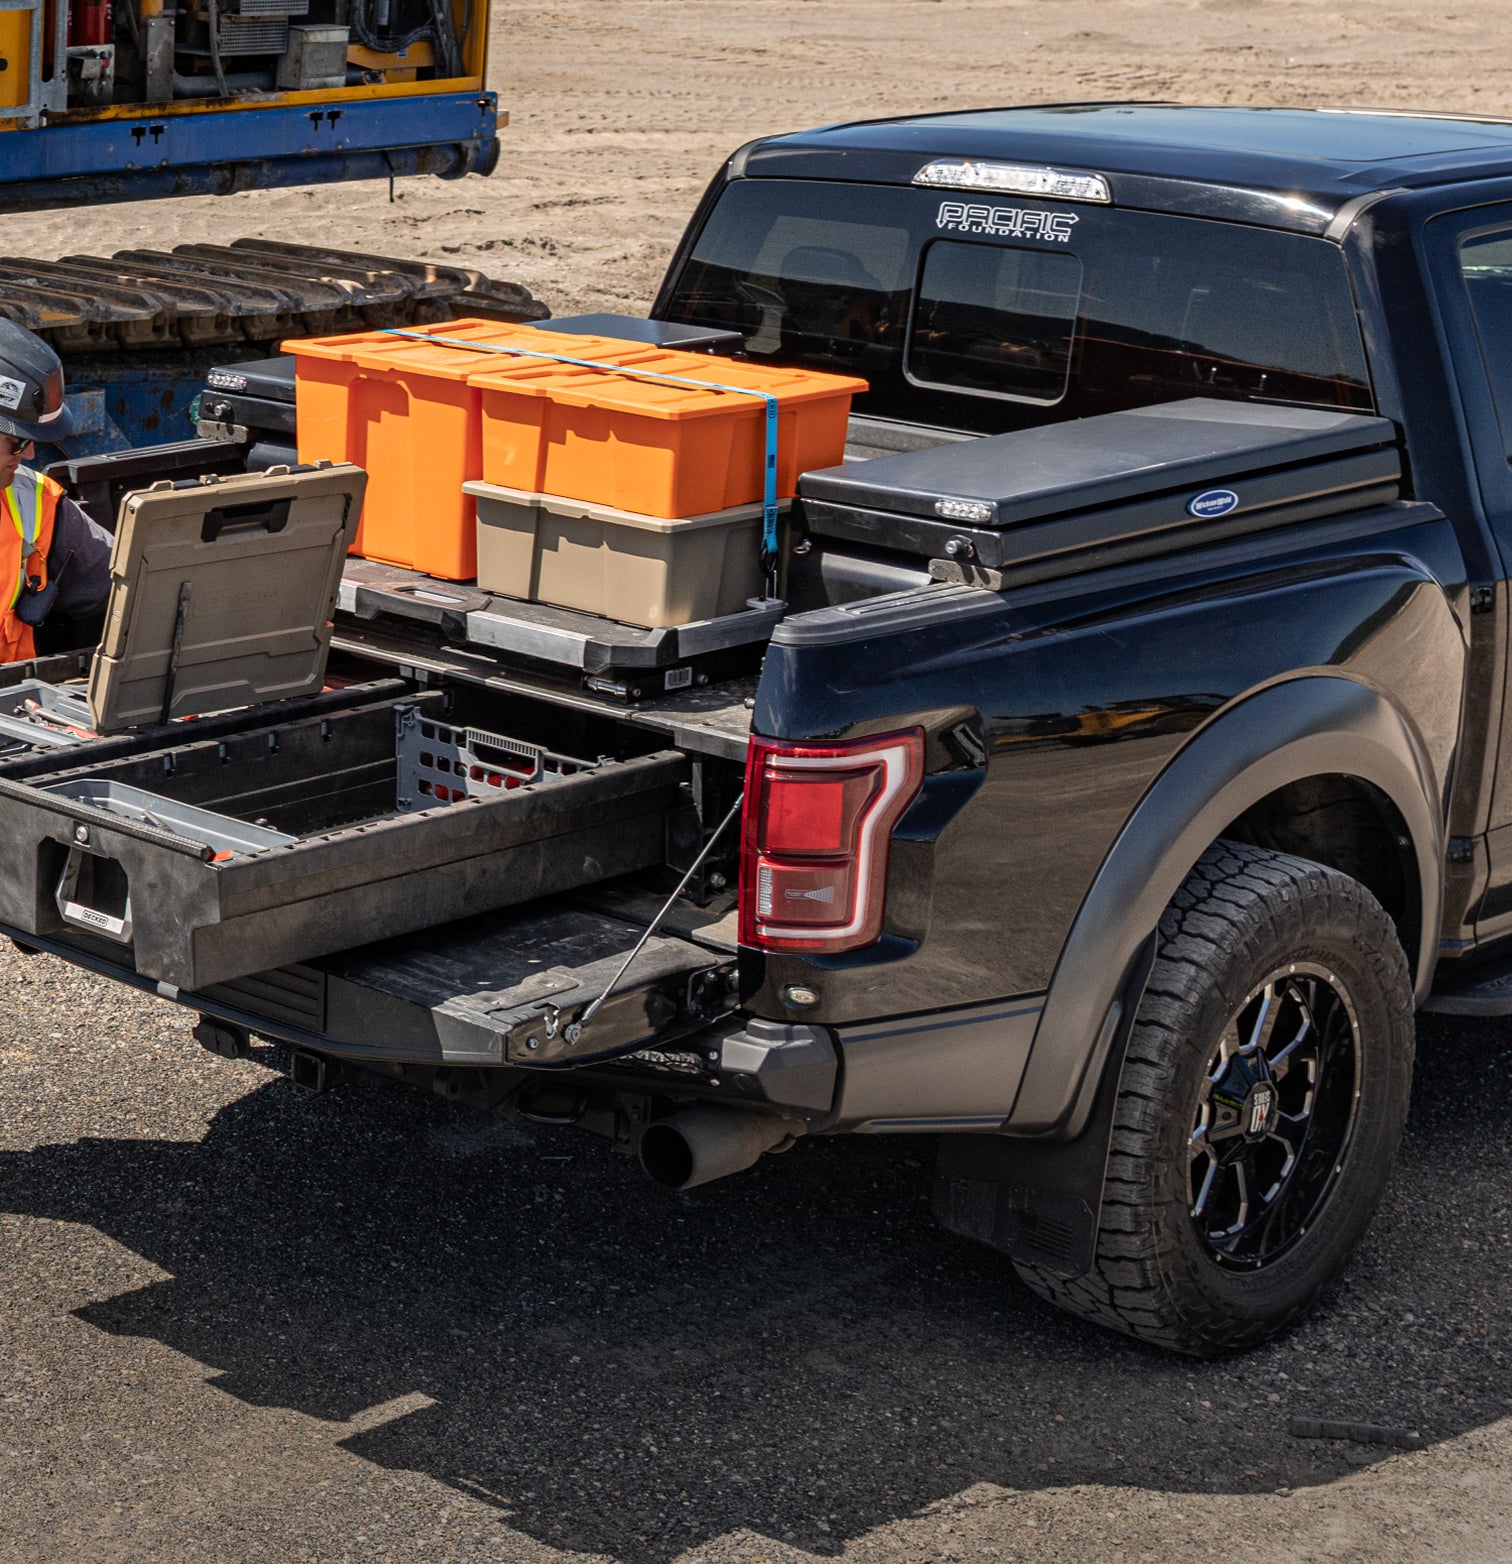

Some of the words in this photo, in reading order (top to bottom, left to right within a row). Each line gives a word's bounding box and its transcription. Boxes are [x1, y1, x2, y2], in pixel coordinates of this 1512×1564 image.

[936, 202, 1080, 235] PACIFIC
[948, 222, 1070, 243] FOUNDATION
[83, 911, 107, 925] DECKED
